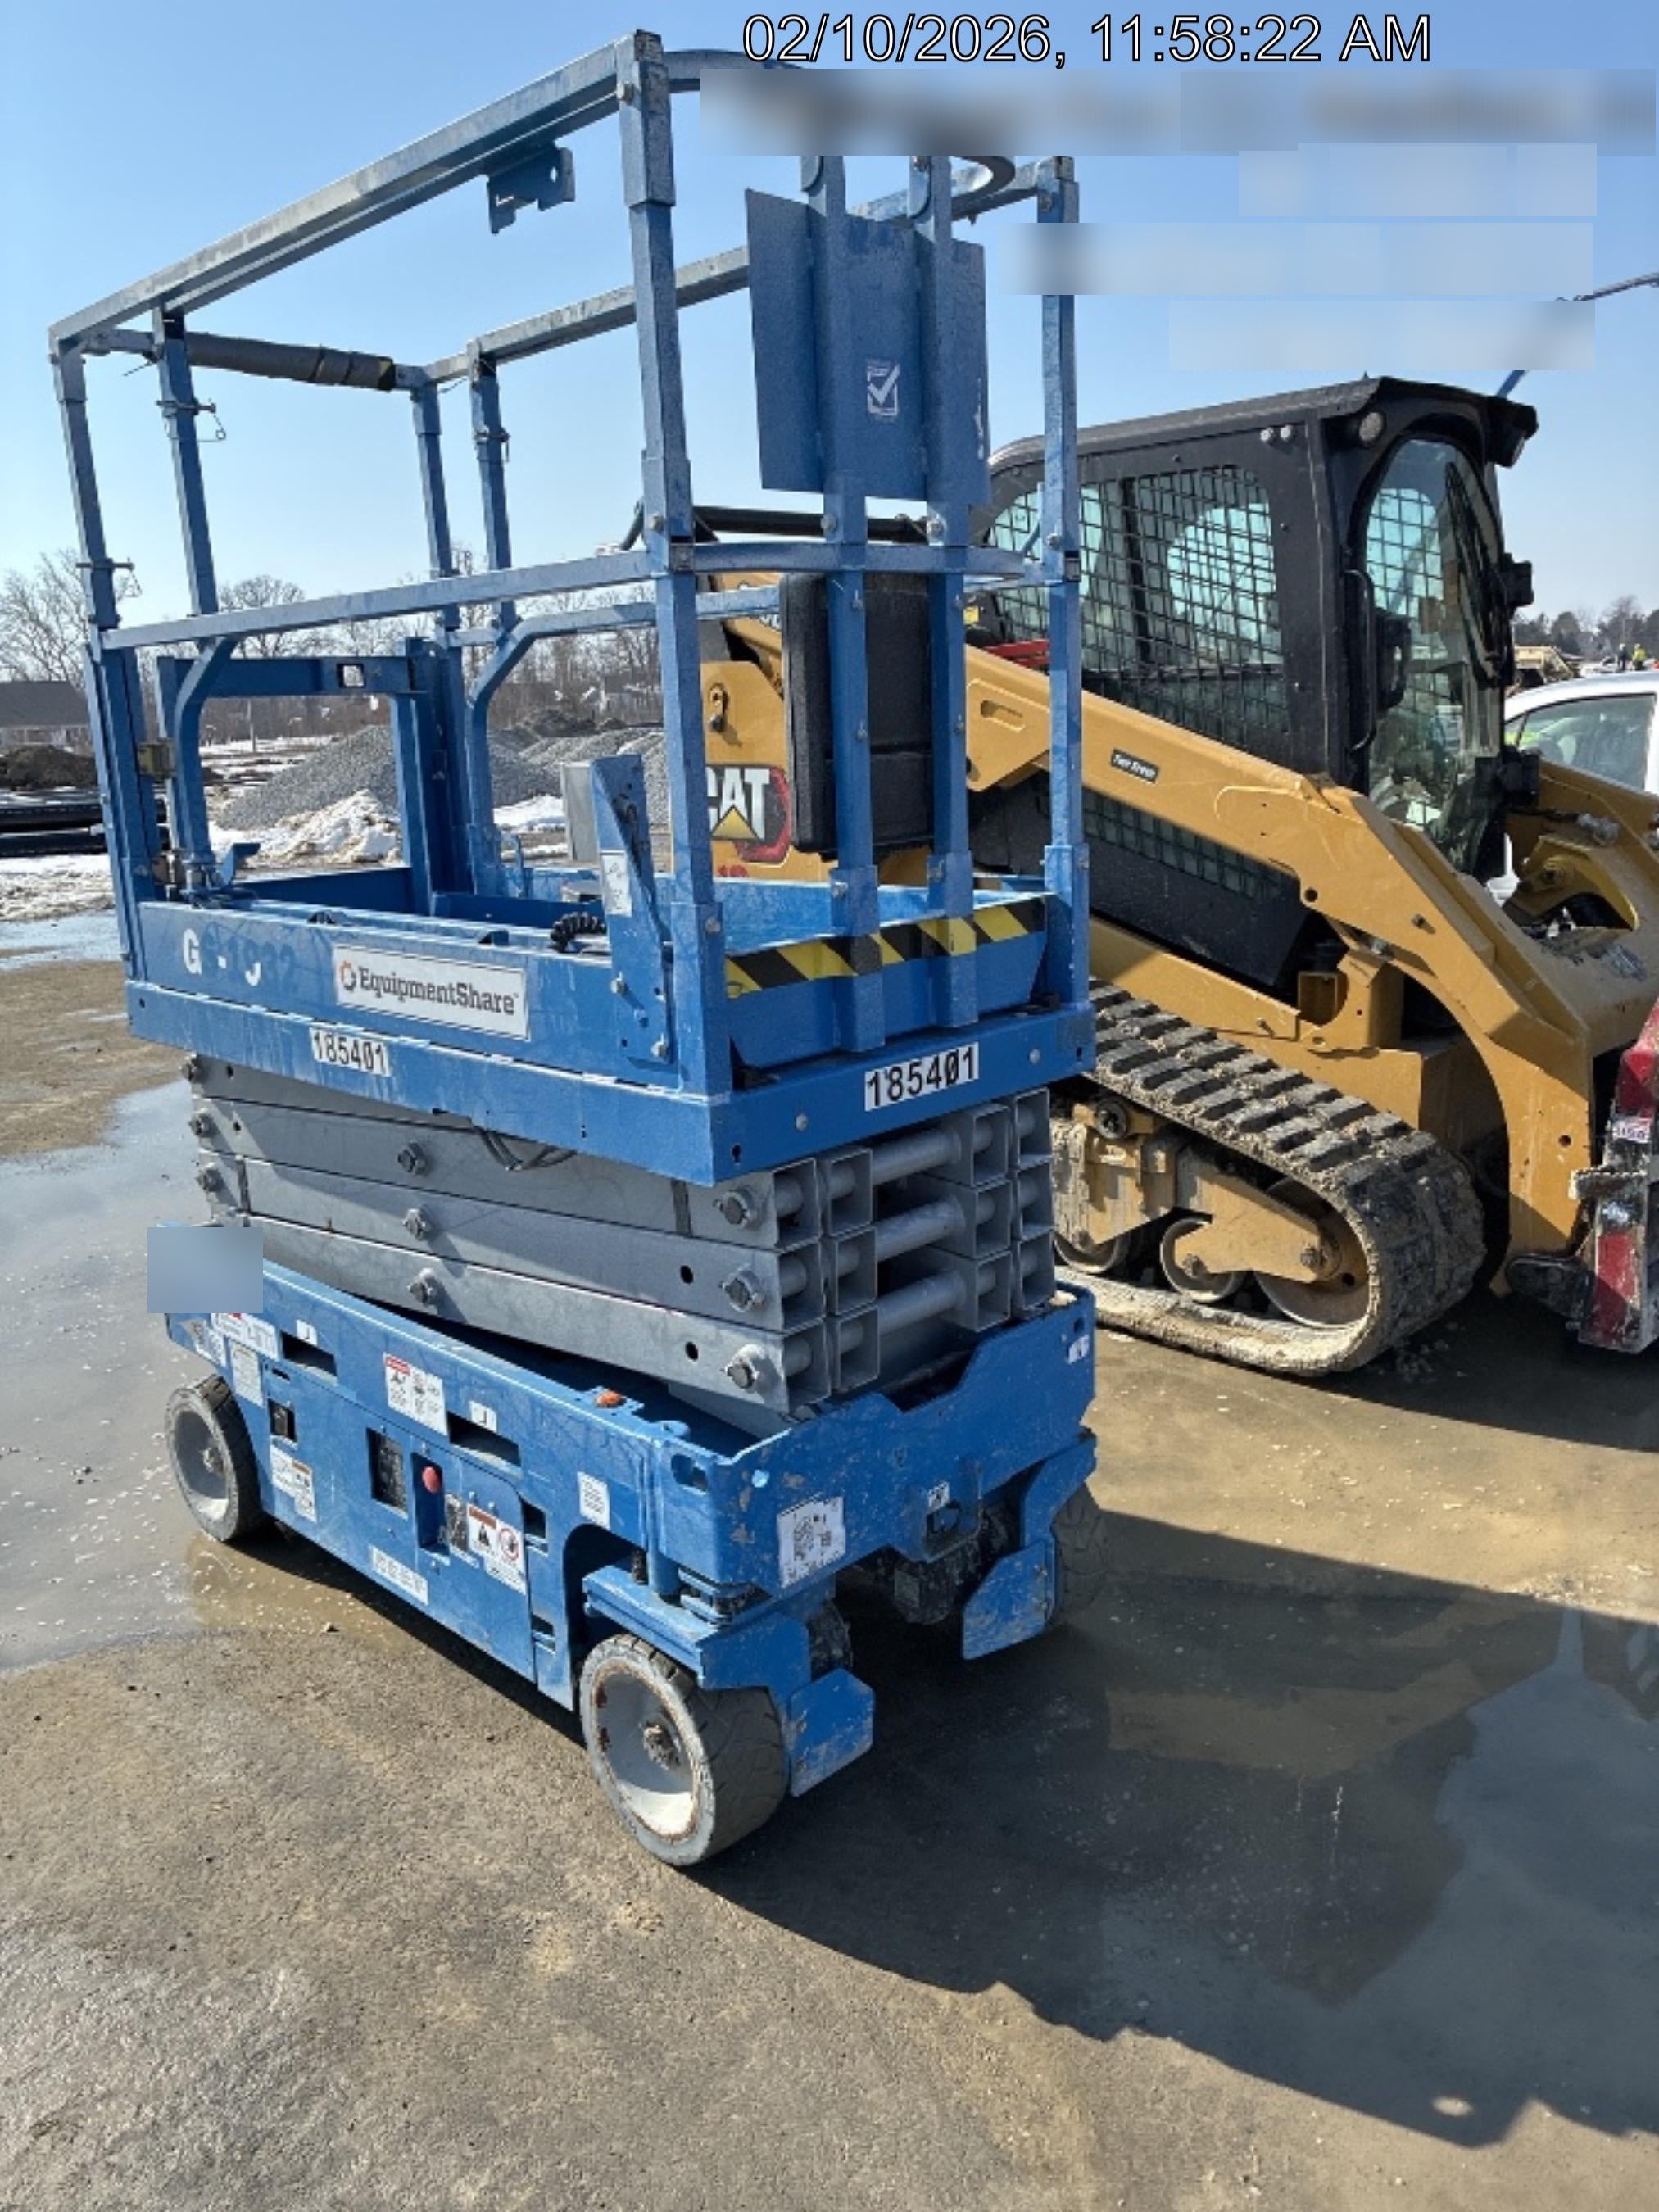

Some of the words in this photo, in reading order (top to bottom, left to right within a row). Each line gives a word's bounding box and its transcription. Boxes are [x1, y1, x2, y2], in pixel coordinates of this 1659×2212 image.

[358, 965, 515, 1016] EquipmentShare
[314, 1031, 387, 1075] 185401
[867, 1046, 975, 1106] 185401
